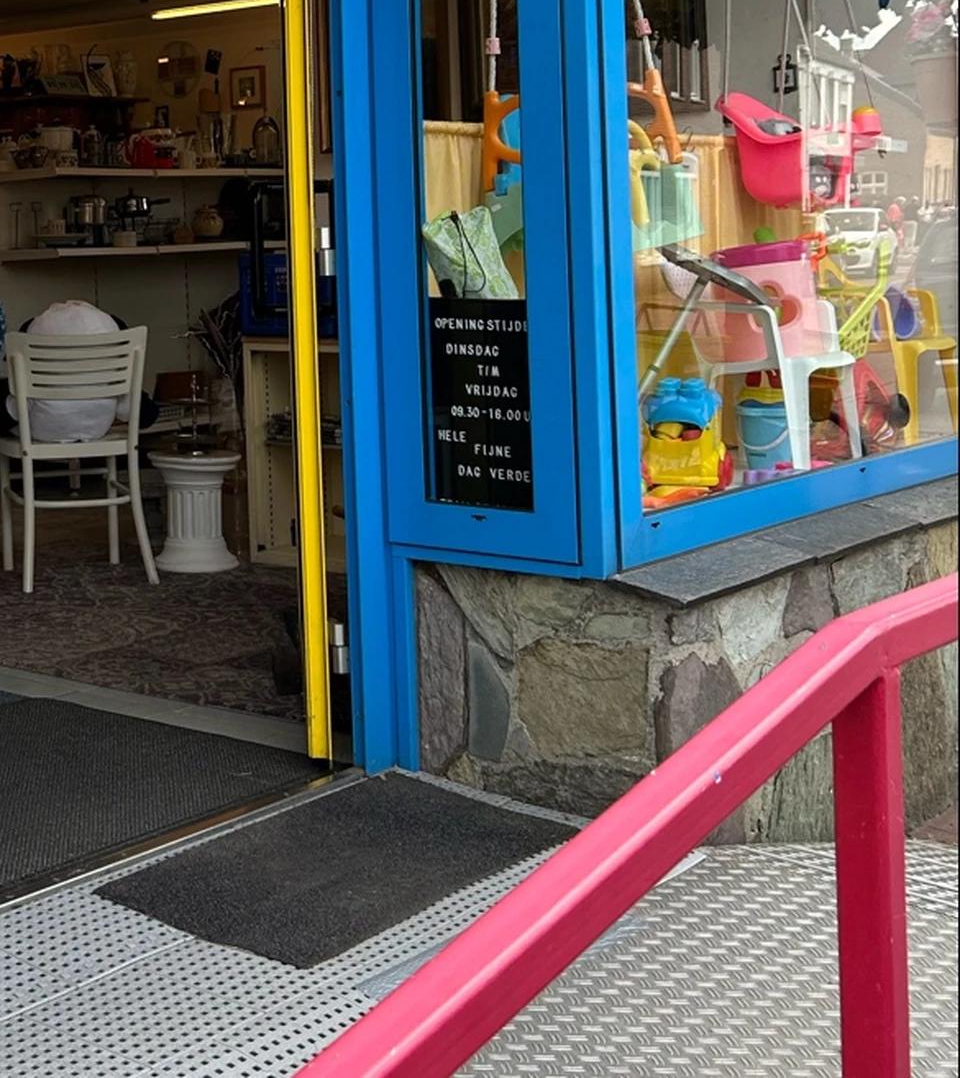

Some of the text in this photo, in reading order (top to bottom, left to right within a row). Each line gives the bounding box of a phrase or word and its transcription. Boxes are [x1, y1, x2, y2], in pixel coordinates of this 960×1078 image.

[445, 342, 500, 357] DINSDAG
[465, 383, 518, 398] VRIJDAG
[437, 429, 467, 443] HELE
[473, 443, 512, 458] FIJNE
[457, 463, 531, 483] DAG VERDE
